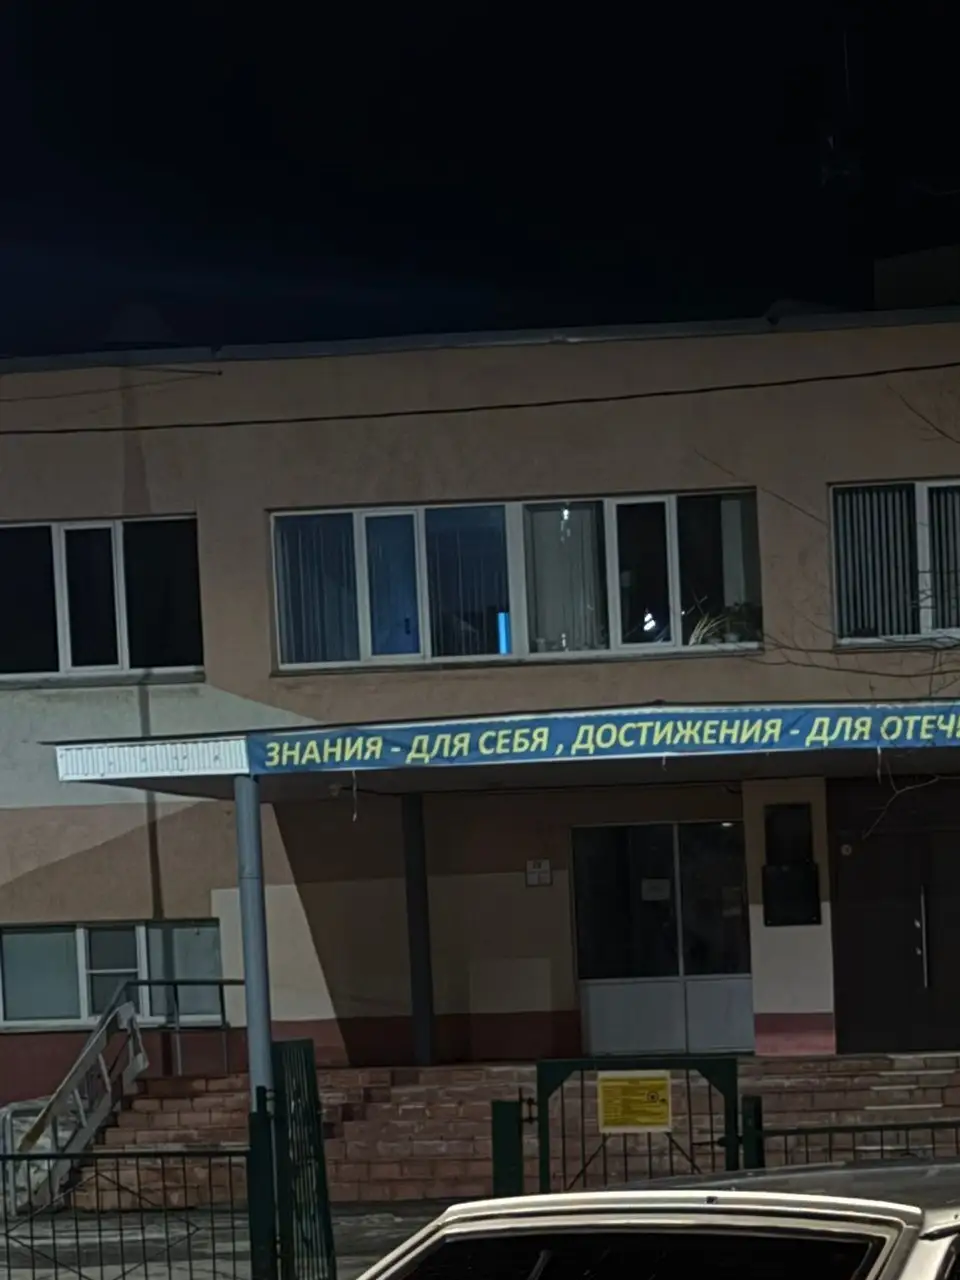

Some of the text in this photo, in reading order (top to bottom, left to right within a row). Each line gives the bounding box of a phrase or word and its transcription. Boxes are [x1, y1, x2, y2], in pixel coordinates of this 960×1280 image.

[265, 735, 383, 767] ЗНАНИЯ
[406, 732, 470, 764] ДЛЯ
[571, 718, 783, 753] ДОСТИЖЕНИЯ
[805, 716, 871, 747] ДЛЯ
